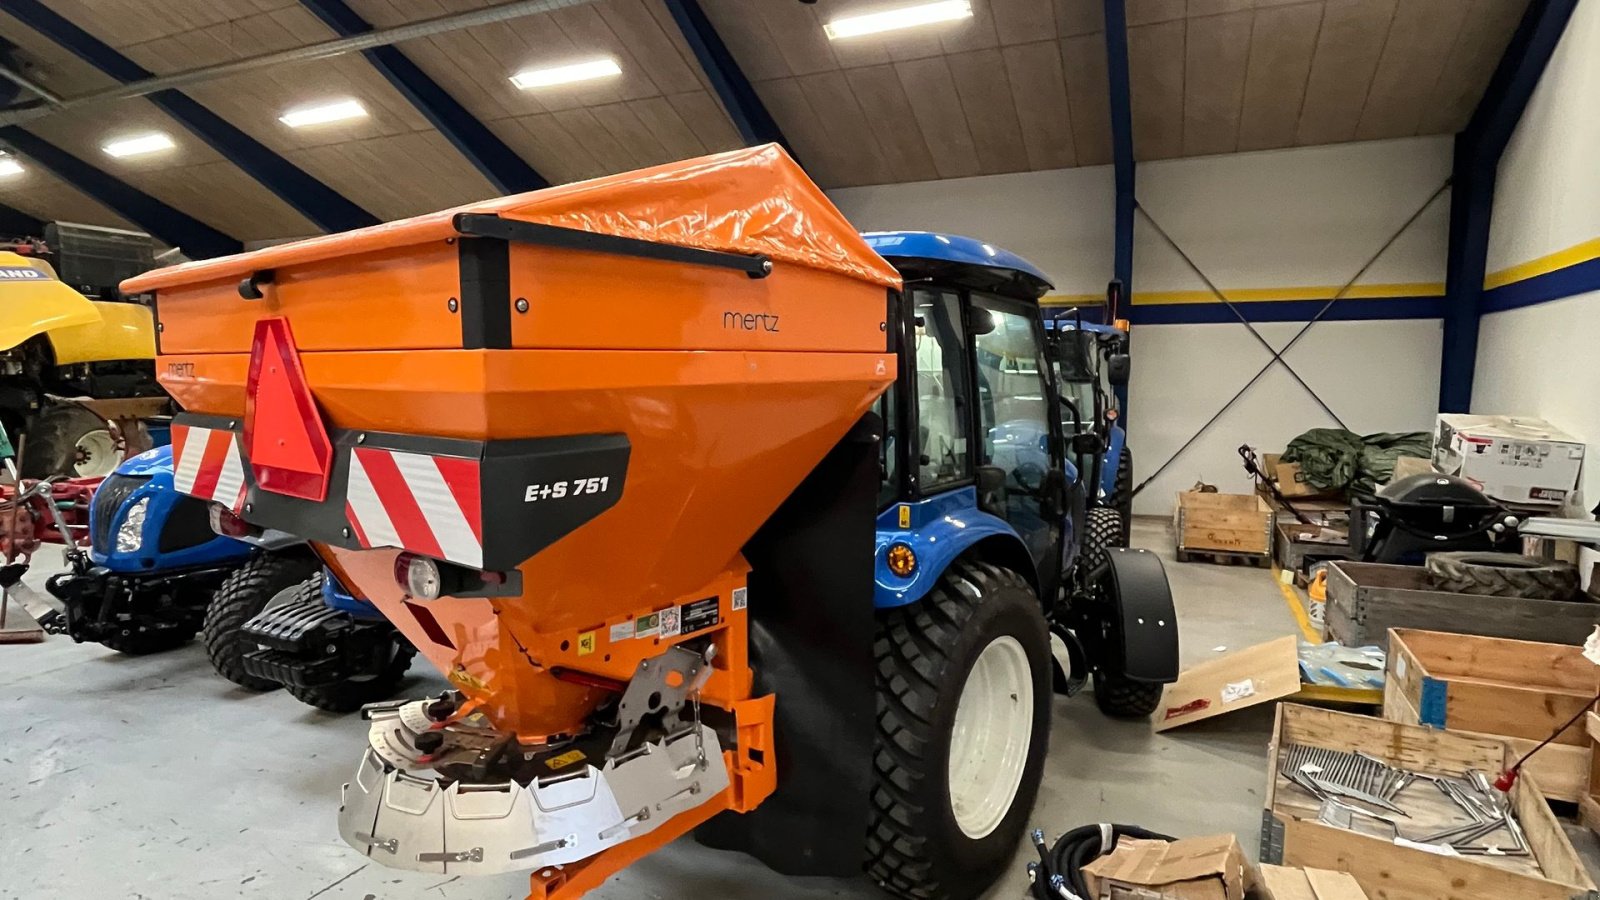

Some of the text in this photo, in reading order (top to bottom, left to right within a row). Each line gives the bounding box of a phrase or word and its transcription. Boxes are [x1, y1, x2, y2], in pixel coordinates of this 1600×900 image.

[723, 311, 780, 332] mertz
[525, 477, 609, 502] E+S 751
